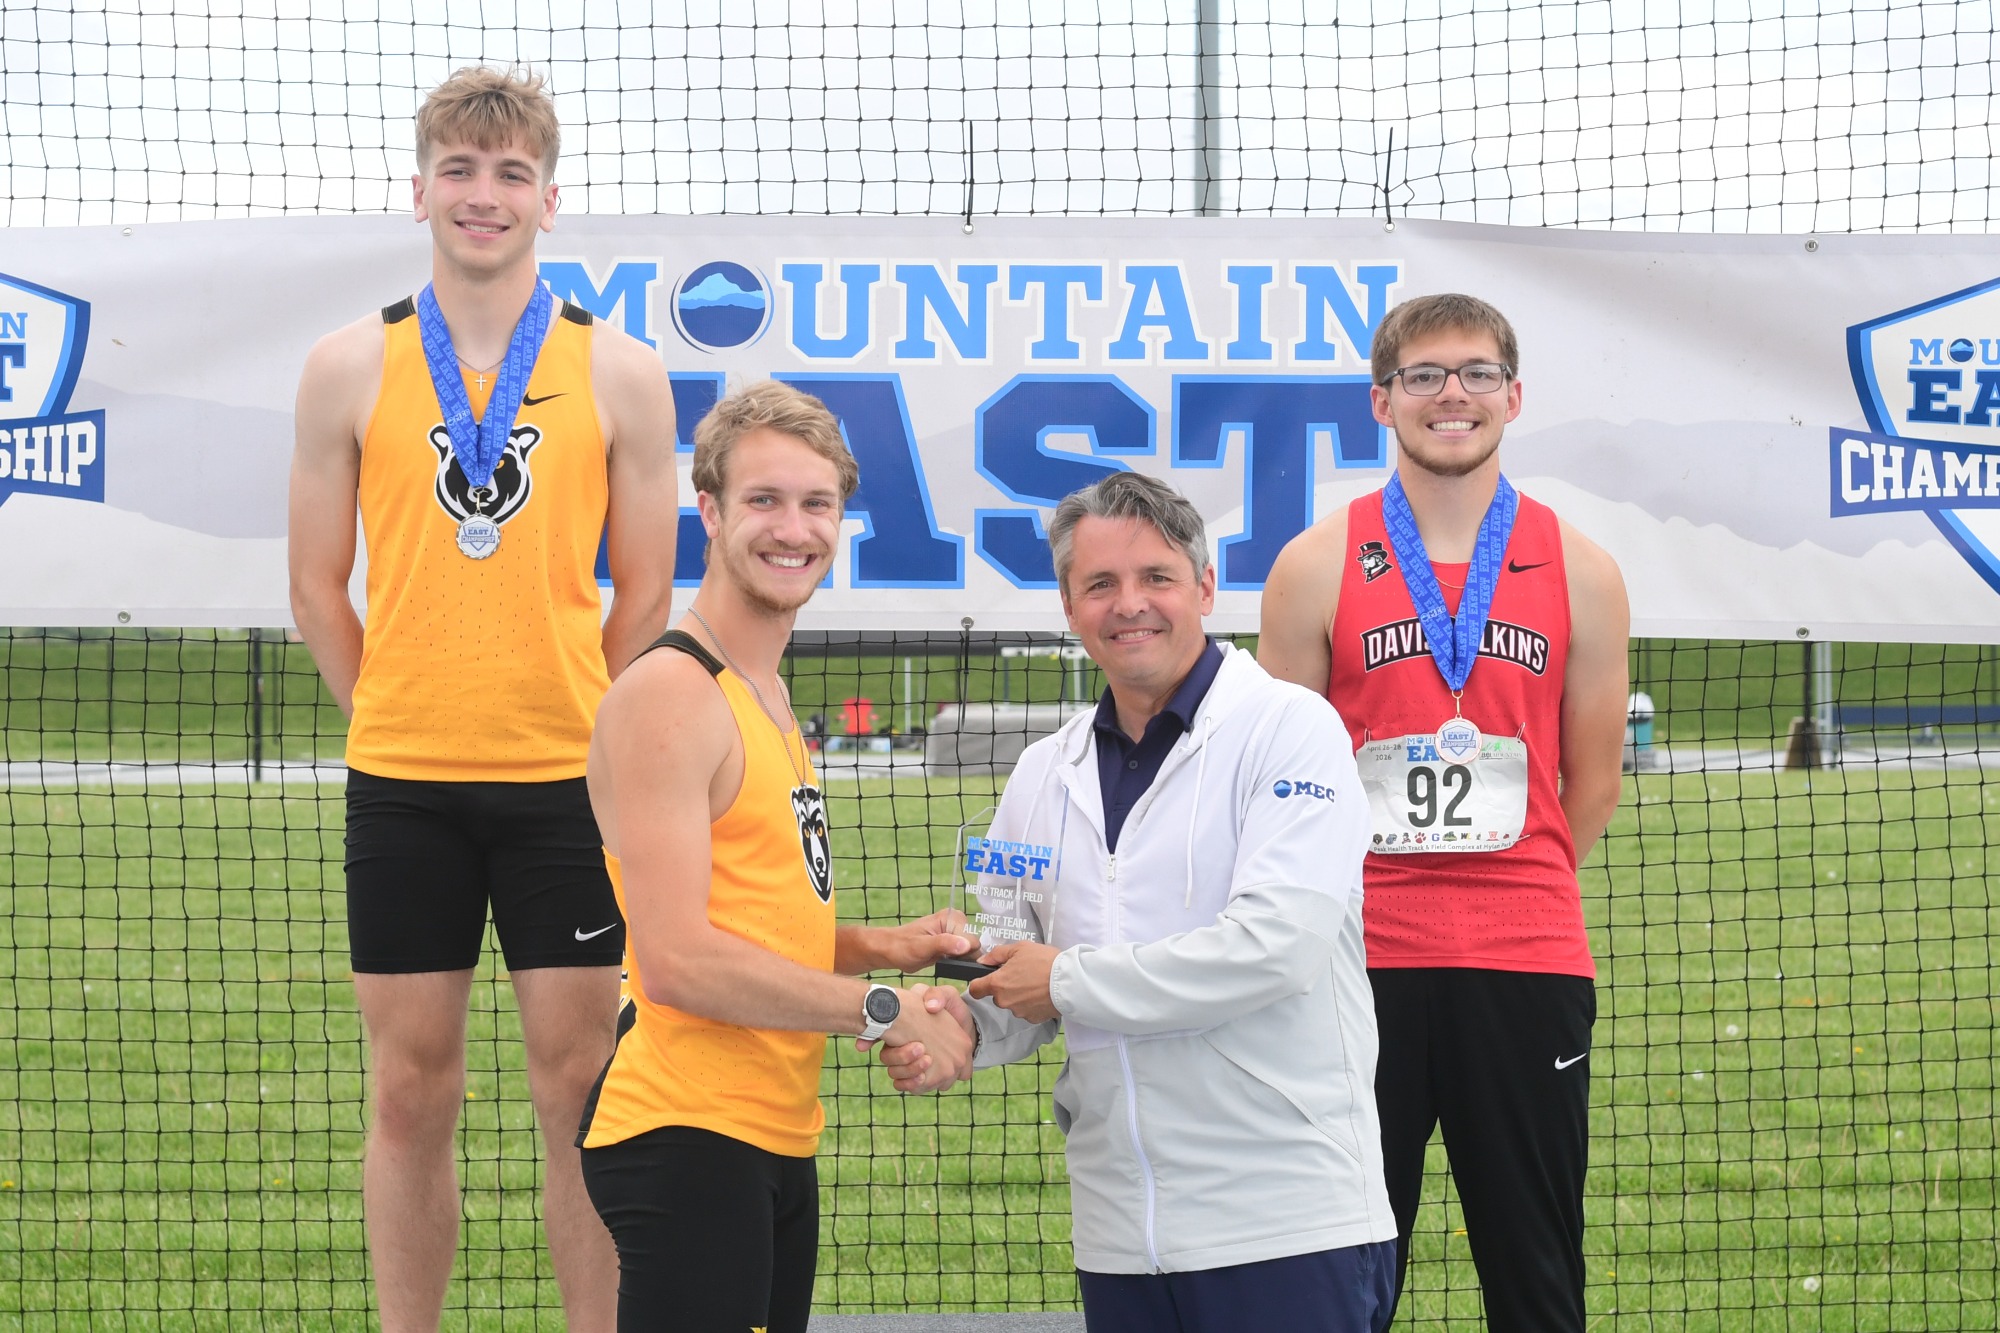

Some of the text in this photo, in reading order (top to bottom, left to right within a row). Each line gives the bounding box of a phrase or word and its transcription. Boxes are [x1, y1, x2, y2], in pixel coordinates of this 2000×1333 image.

[541, 260, 1402, 362] MOUNTAIN
[1479, 624, 1546, 671] LKINS
[1294, 781, 1335, 803] MEC
[1407, 764, 1472, 828] 92
[968, 836, 1053, 858] MOUNTAIN
[965, 848, 1050, 881] EAST
[990, 887, 1014, 899] TRACK
[1023, 891, 1043, 903] FIELD
[975, 913, 1027, 929] FIRST TEAM
